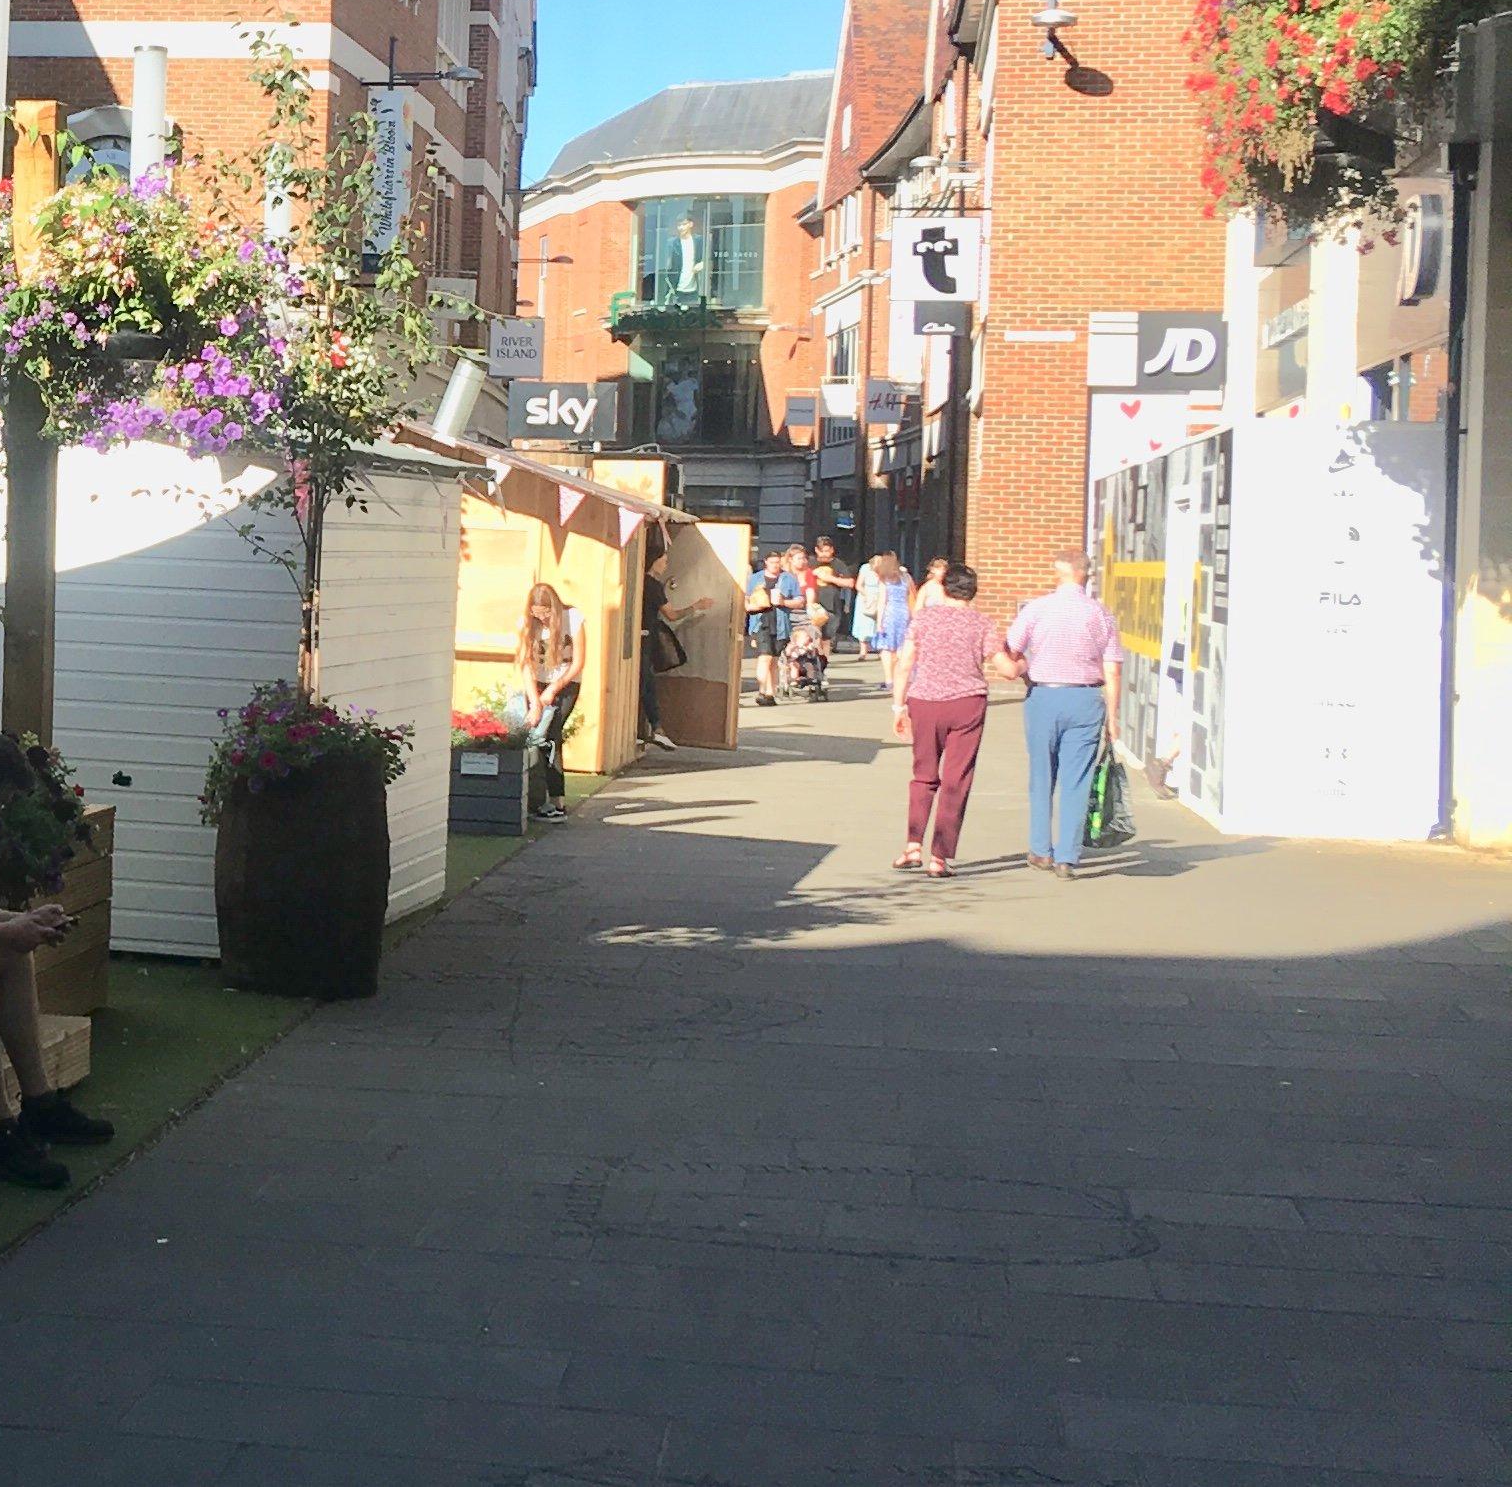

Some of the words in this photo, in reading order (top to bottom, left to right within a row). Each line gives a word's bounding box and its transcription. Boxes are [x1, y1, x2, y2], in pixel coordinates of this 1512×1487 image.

[384, 120, 396, 156] Bloom
[378, 169, 397, 235] Whitefriars
[496, 348, 537, 359] ISLAND
[501, 336, 533, 347] RIVER
[1143, 328, 1217, 374] JD
[526, 389, 598, 434] sky
[1320, 592, 1362, 605] FILA
